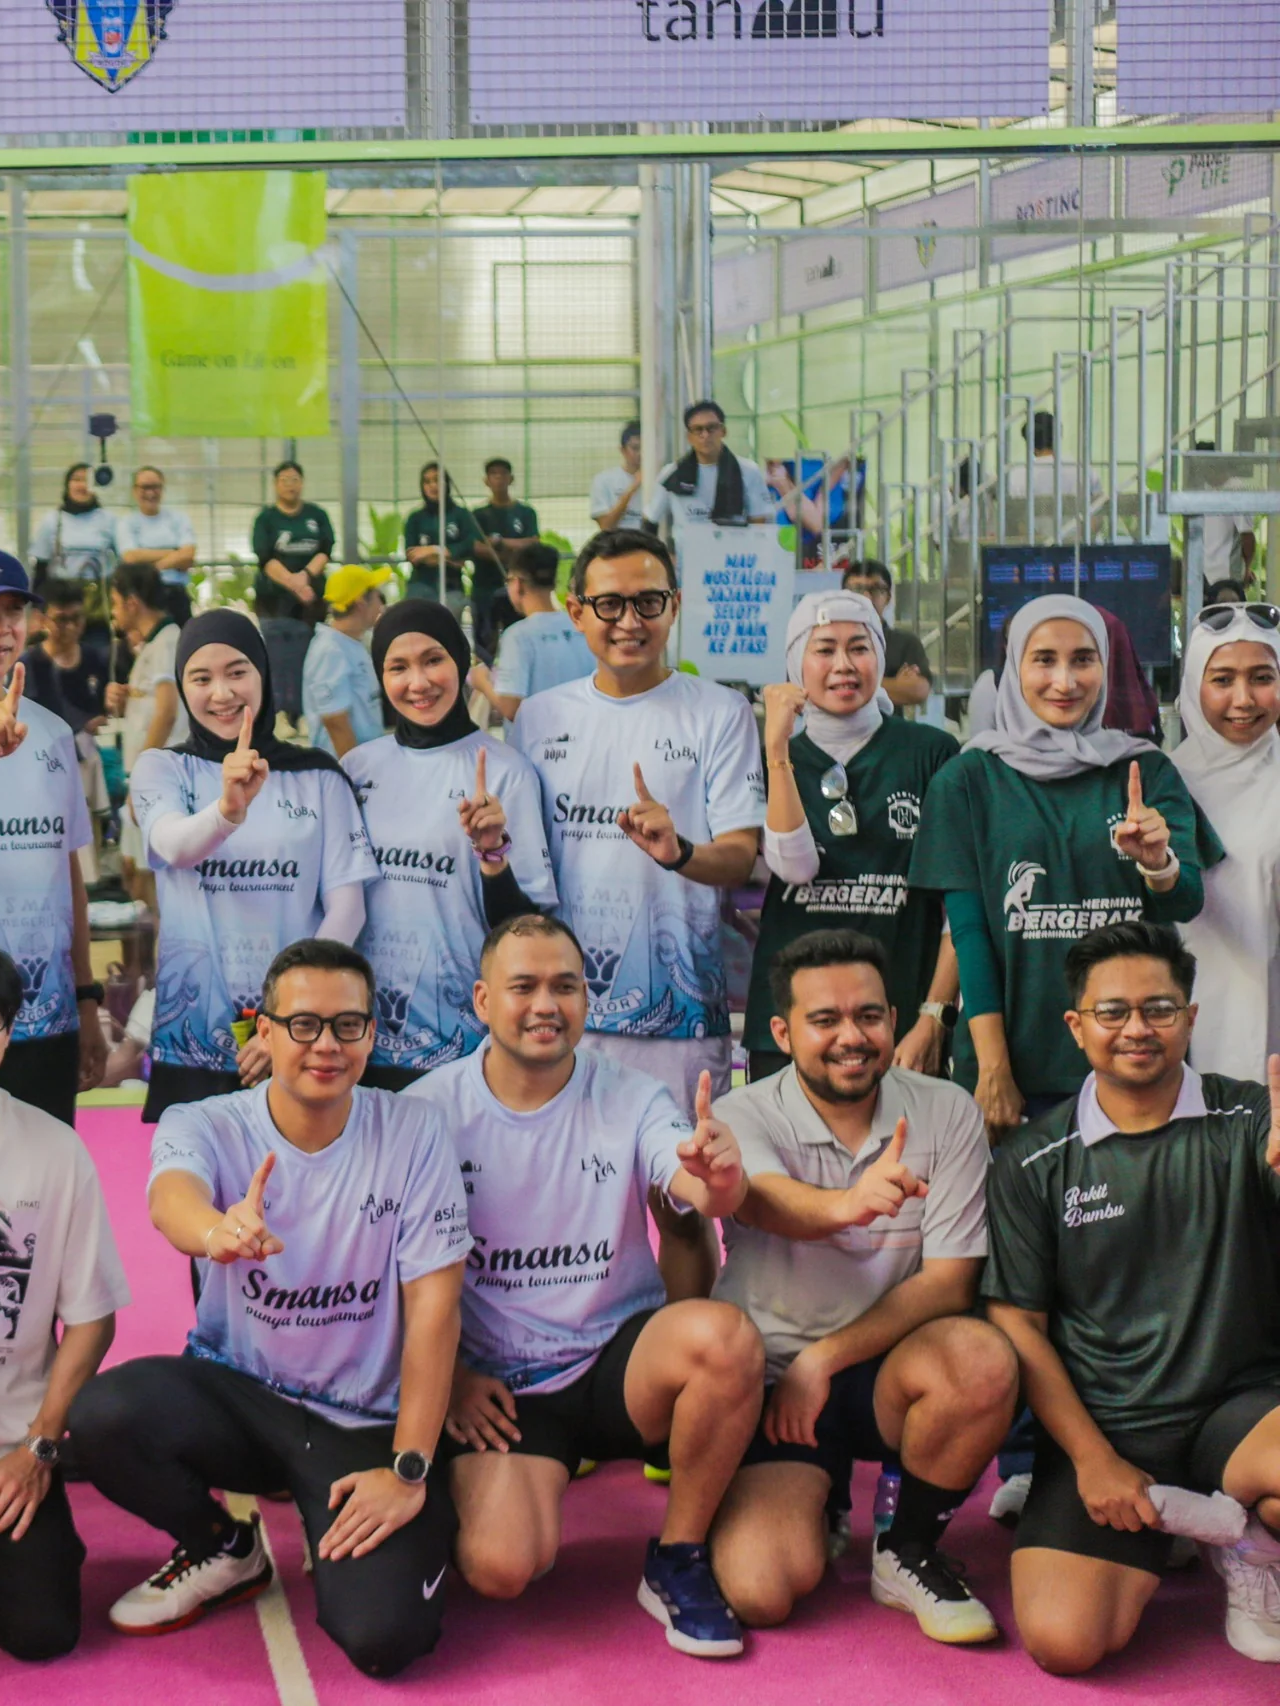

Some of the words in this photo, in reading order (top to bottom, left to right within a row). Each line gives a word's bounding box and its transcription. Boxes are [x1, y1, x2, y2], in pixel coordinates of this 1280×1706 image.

[725, 554, 757, 568] MAU
[703, 622, 730, 637] AYO
[708, 639, 725, 653] KE
[654, 738, 672, 750] LA
[664, 746, 698, 764] LOBA
[277, 799, 293, 810] LA
[288, 806, 317, 820] LOBA
[195, 857, 300, 879] mansa
[1082, 897, 1143, 909] HERMINA
[16, 1002, 52, 1021] OGOR
[1065, 1183, 1108, 1208] Rakit
[1064, 1202, 1125, 1227] Bambu
[466, 1236, 615, 1271] Smansa
[475, 1275, 523, 1291] punya
[528, 1267, 610, 1287] tournament
[242, 1268, 381, 1310] Smansa
[245, 1305, 291, 1329] punya
[295, 1305, 375, 1327] tournament
